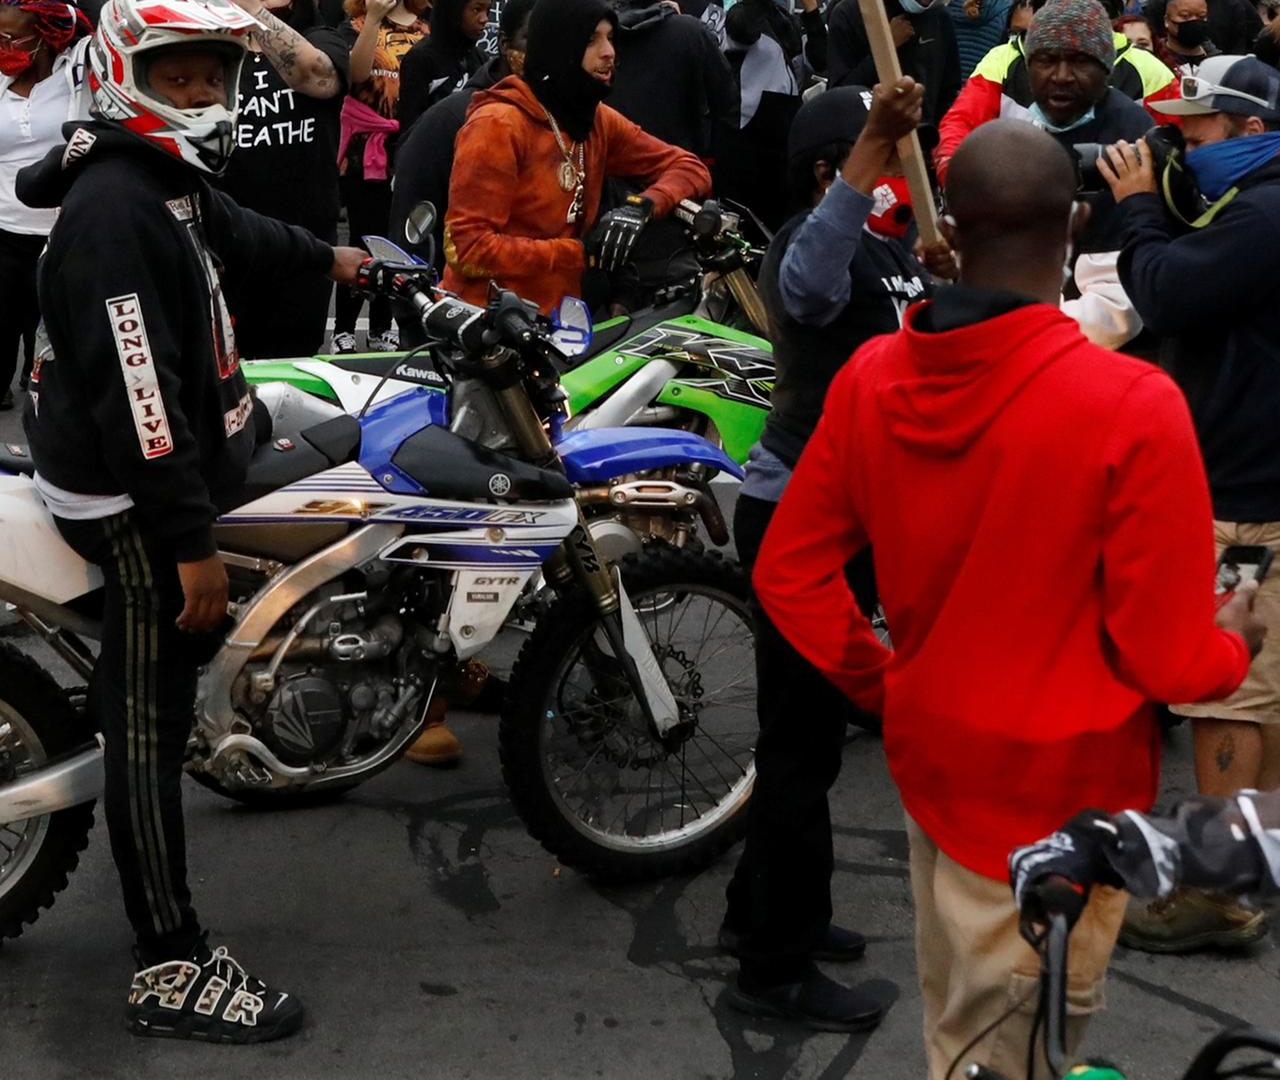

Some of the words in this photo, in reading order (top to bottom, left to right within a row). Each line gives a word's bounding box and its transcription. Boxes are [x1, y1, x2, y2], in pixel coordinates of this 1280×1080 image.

[253, 71, 269, 90] I
[114, 304, 147, 367] LONG
[134, 387, 167, 451] LIVE
[473, 577, 520, 585] GYTR
[128, 960, 263, 1026] AIR
